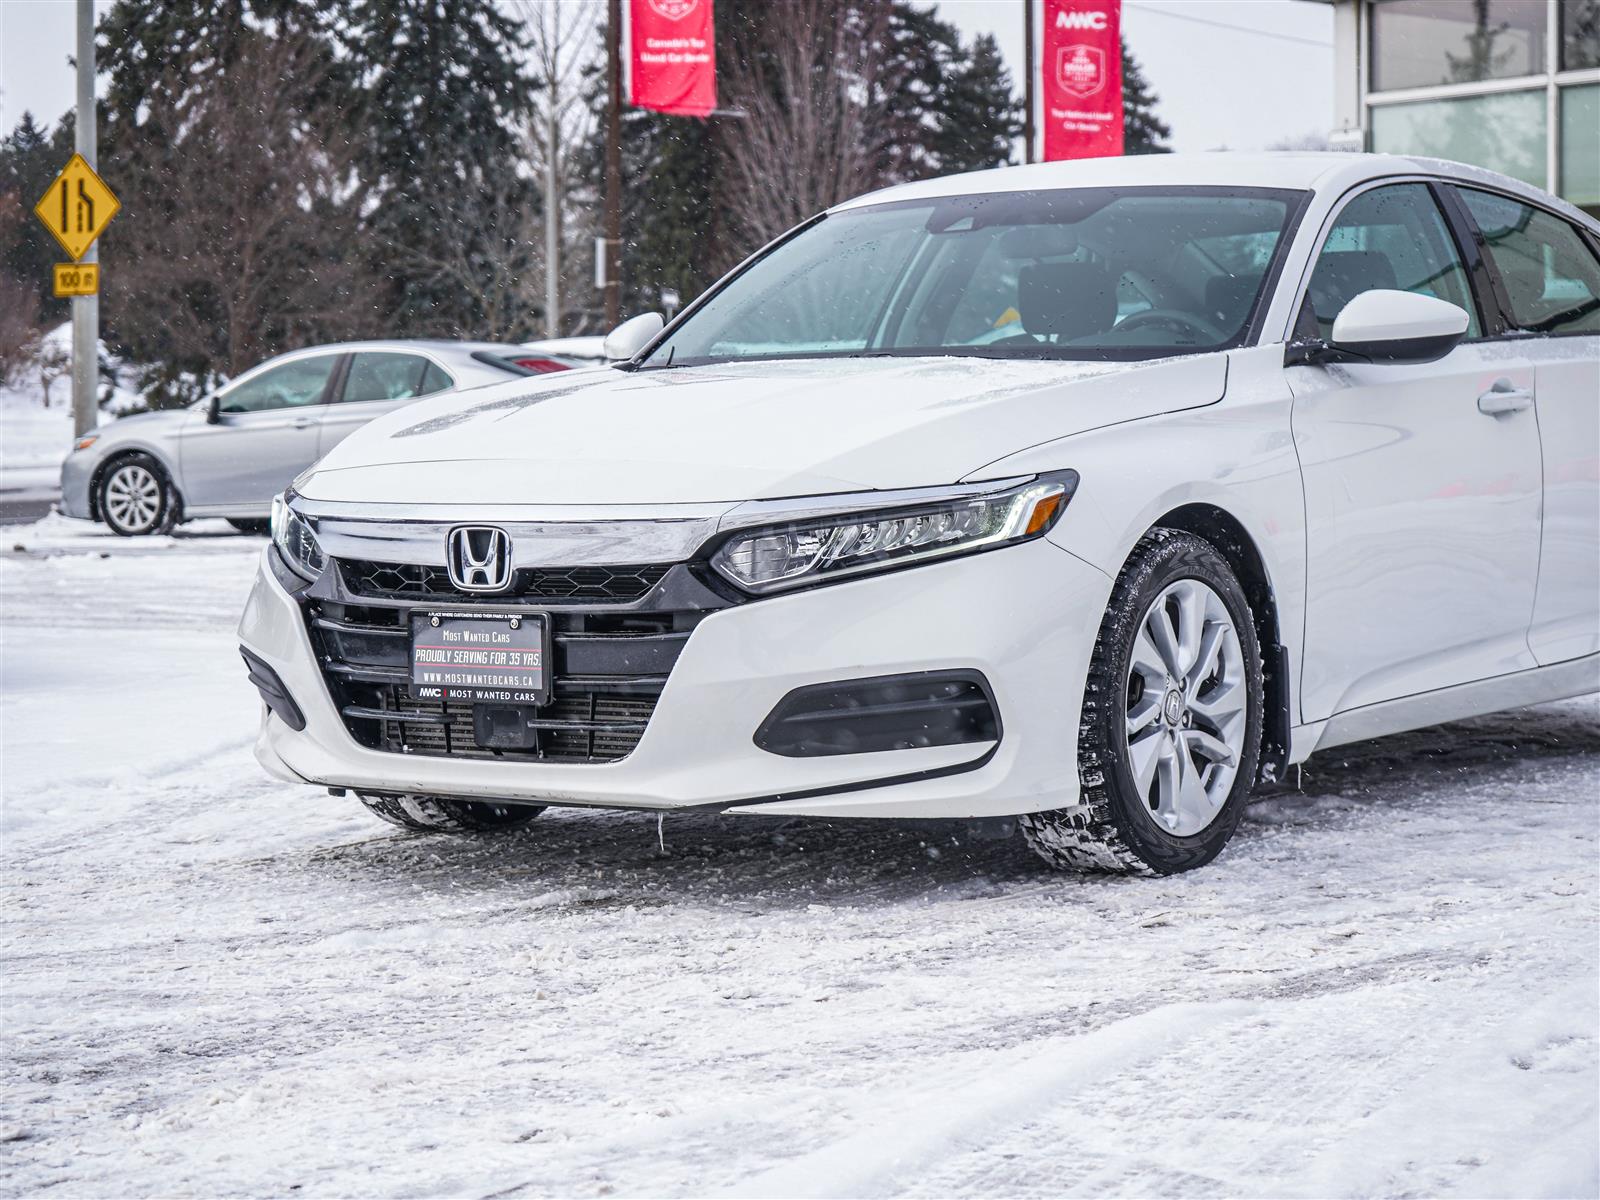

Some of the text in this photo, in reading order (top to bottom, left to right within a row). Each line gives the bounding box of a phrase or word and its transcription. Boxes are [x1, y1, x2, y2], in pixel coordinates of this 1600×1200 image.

[1056, 11, 1108, 29] MWC
[60, 271, 80, 288] 100
[415, 649, 452, 663] PROUDLY
[454, 651, 488, 665] SERVING
[490, 652, 507, 665] FOR
[509, 652, 521, 666] 35
[423, 673, 533, 686] WWW.MOSTWANTEDCARS.CA
[420, 688, 535, 701] MWC MOST WANTED CARS
